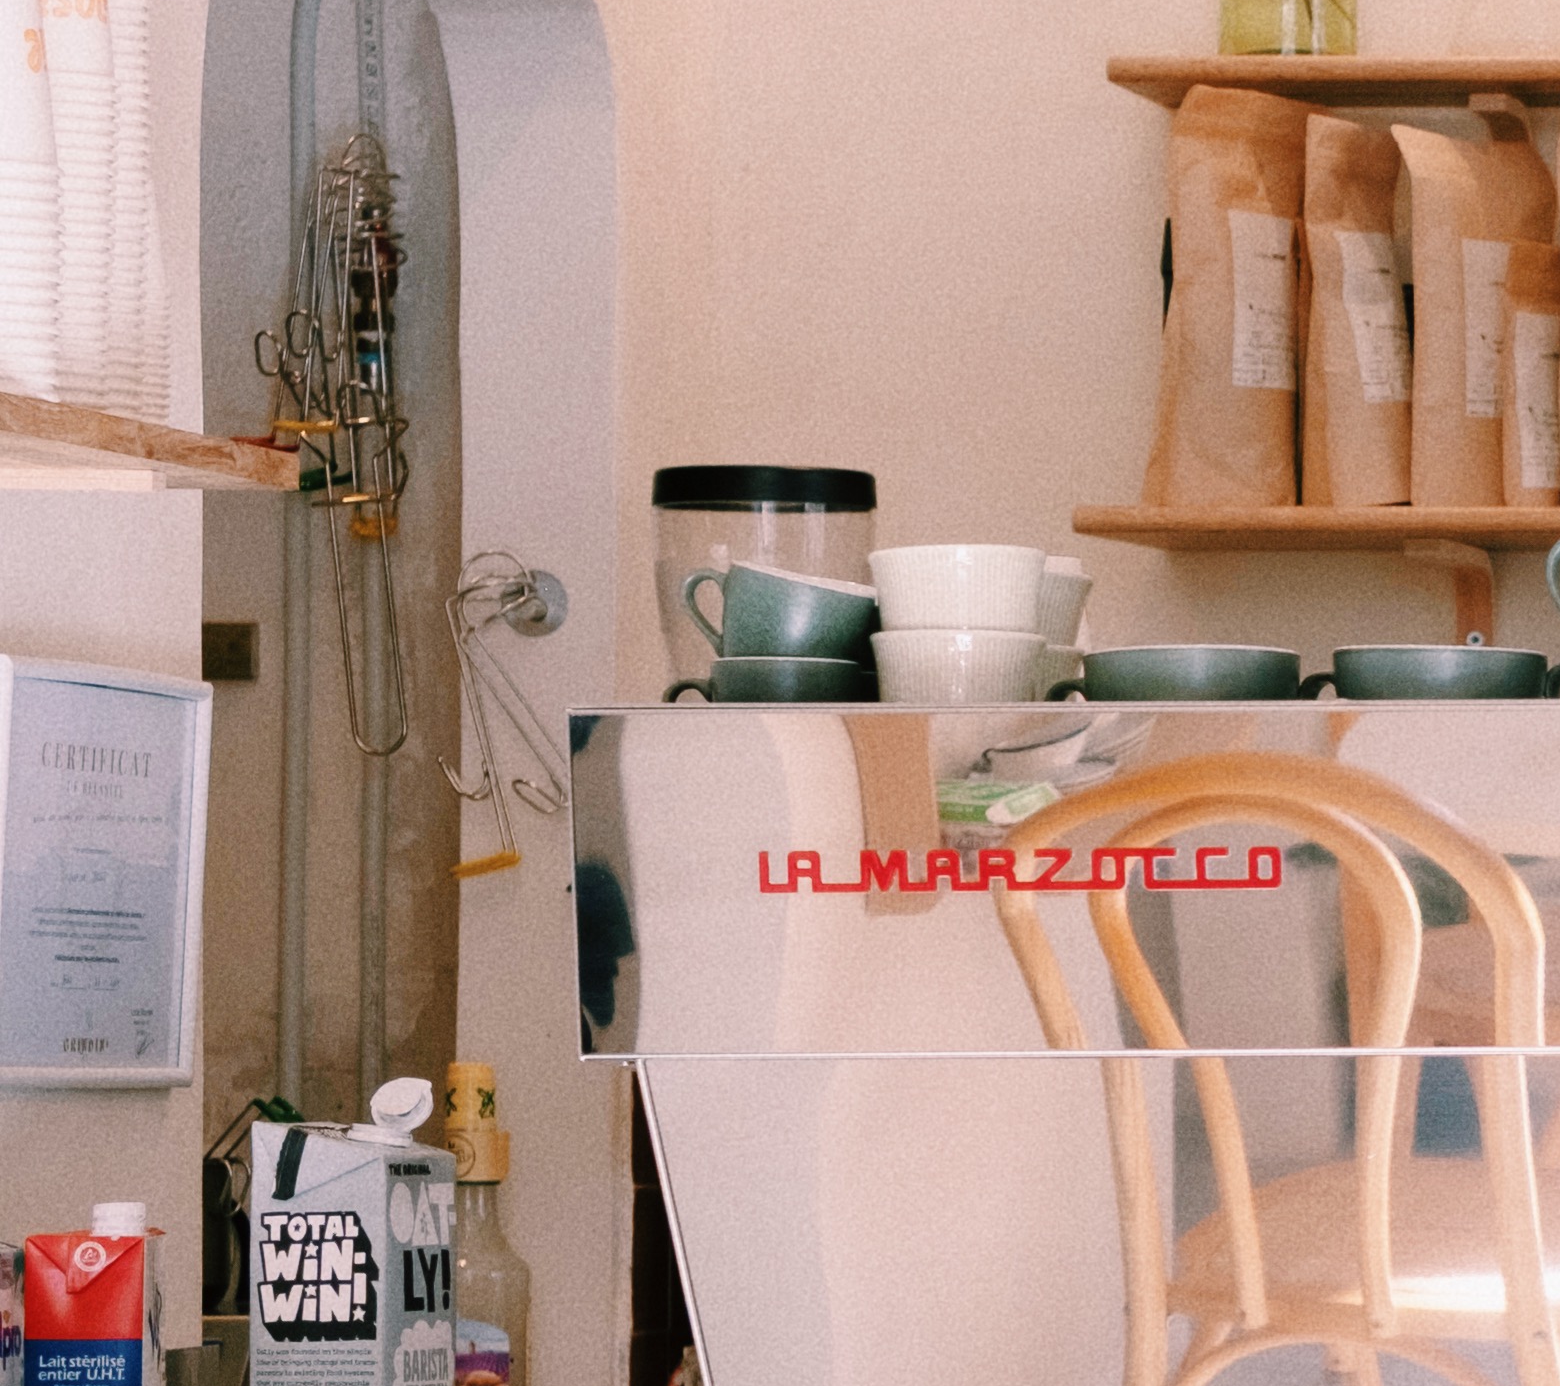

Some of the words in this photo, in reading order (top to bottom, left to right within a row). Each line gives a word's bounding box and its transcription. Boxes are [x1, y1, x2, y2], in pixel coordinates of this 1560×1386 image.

[41, 741, 152, 779] CERTIFICAT
[760, 849, 823, 893] LA
[860, 846, 1283, 892] MARZOCCO
[263, 1214, 360, 1242] TOTAL
[38, 1355, 68, 1369] Lait
[69, 1354, 126, 1369] stérilisé
[38, 1368, 82, 1382] entier
[402, 1348, 449, 1382] BARISTA
